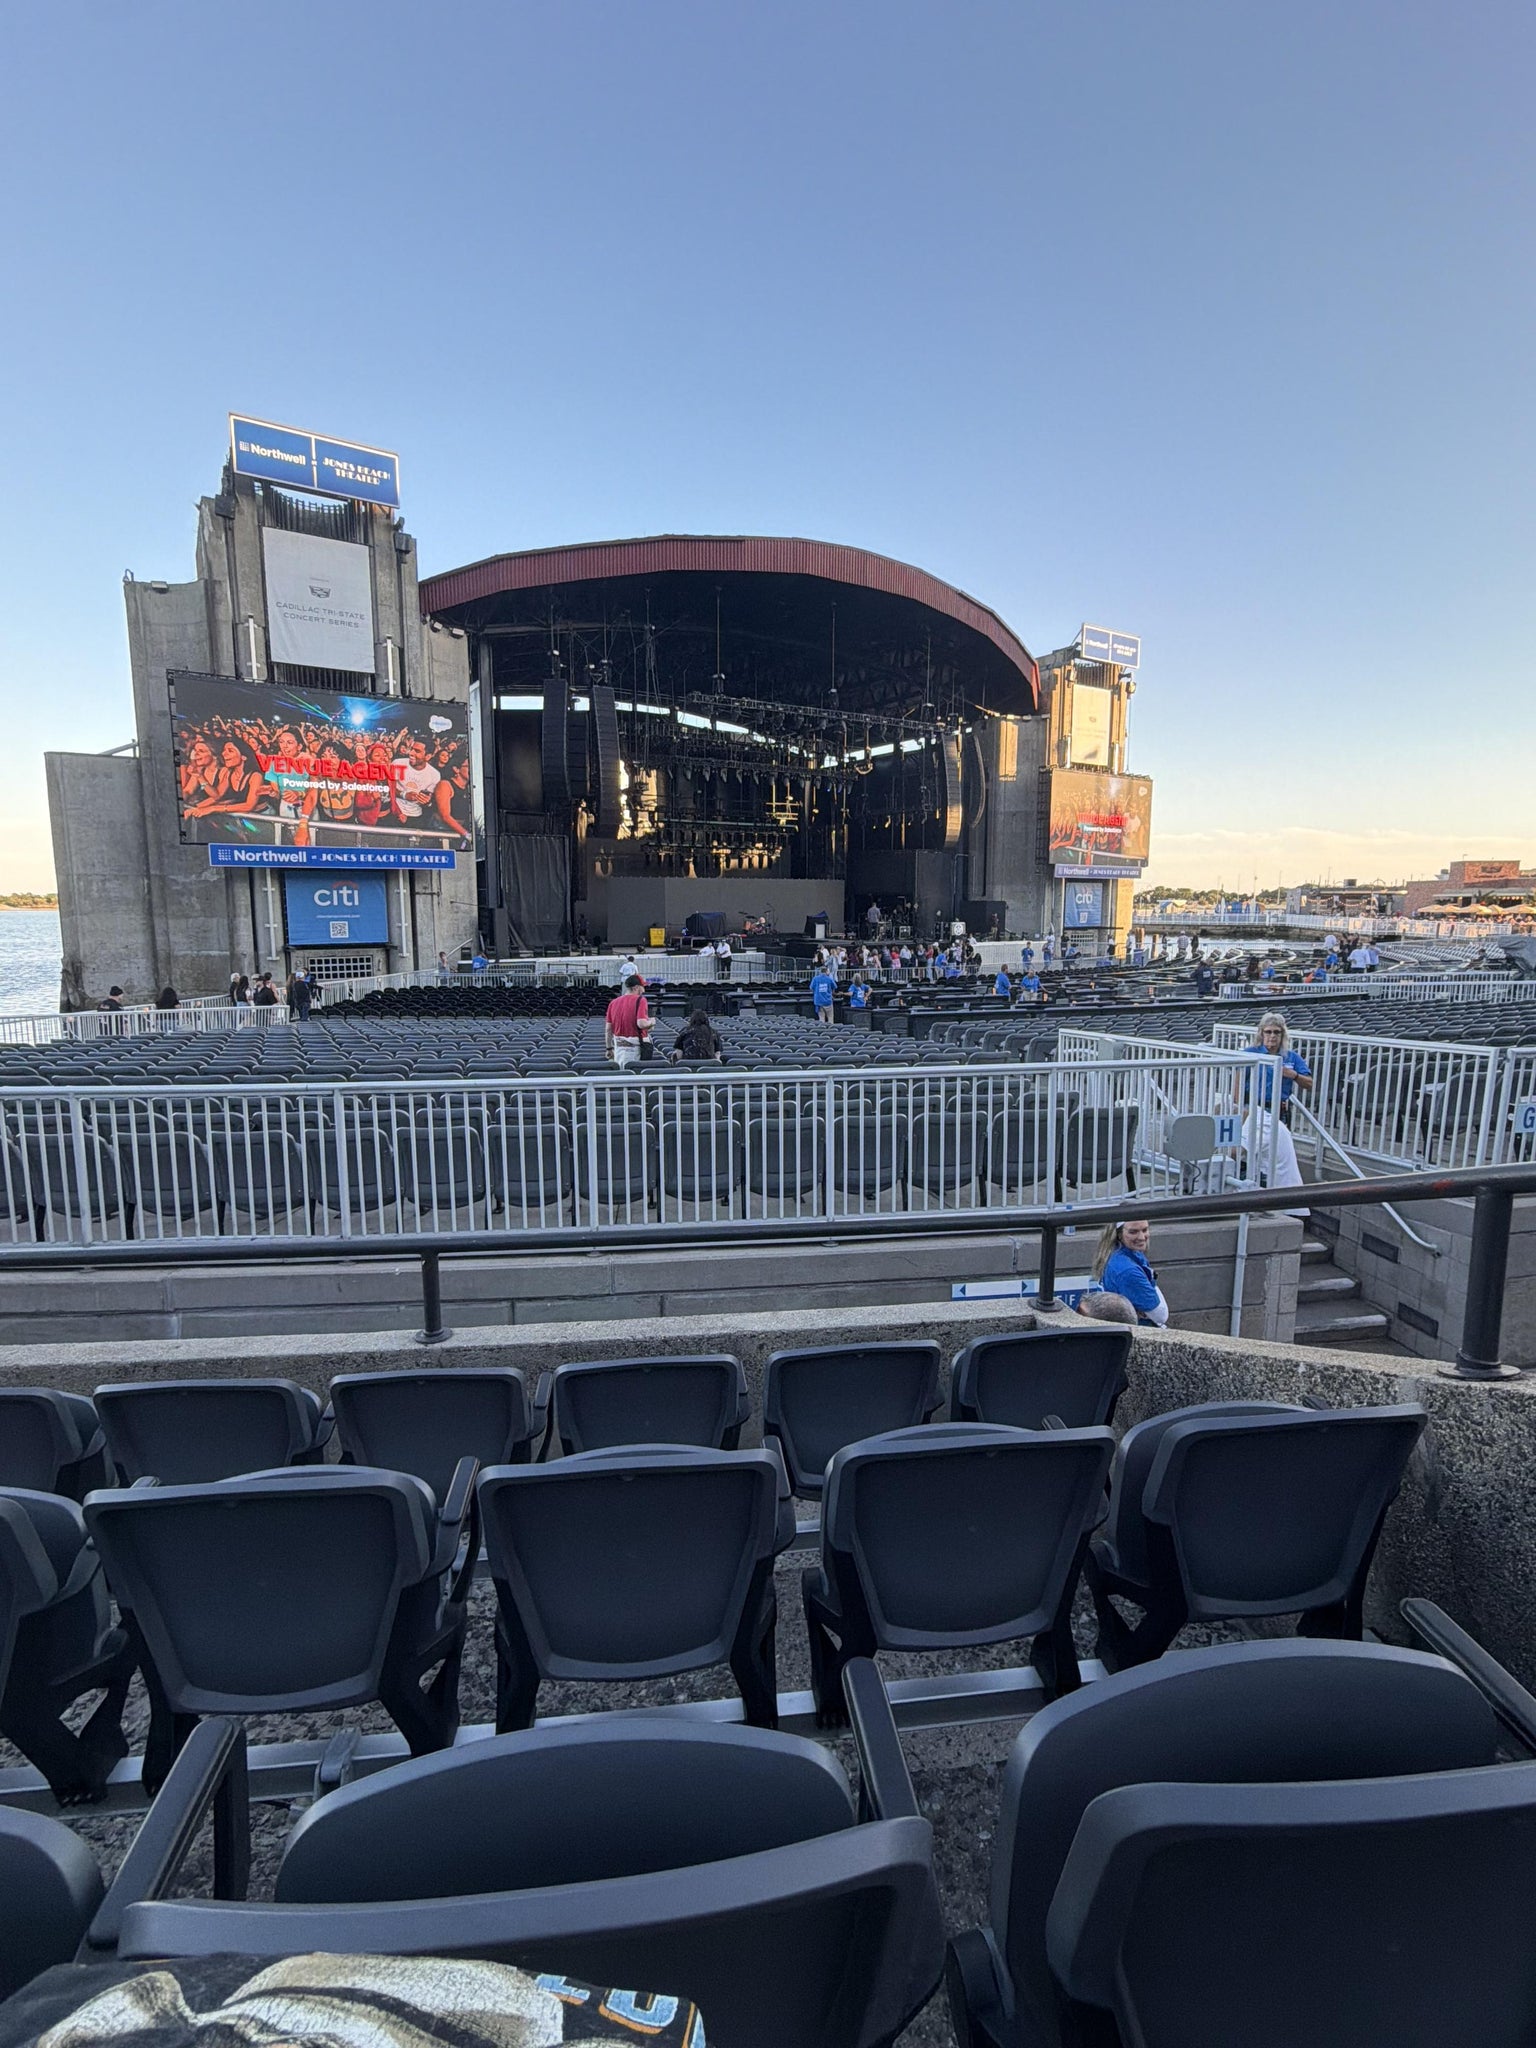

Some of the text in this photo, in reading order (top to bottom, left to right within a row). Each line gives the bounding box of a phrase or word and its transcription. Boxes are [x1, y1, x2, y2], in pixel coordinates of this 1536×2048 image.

[250, 443, 306, 466] Northwell
[322, 457, 355, 472] JONES
[275, 601, 320, 614] CADILLAC
[283, 612, 360, 629] CONCERT SERIES
[255, 754, 409, 781] VENUE AGENT
[282, 778, 326, 790] Powered
[327, 780, 341, 791] by
[233, 849, 307, 863] Northwell
[320, 853, 357, 862] JONES
[360, 853, 397, 863] BEACH
[400, 854, 450, 864] THEATER
[313, 885, 359, 907] citi
[1523, 1106, 1536, 1129] G
[1219, 1118, 1234, 1143] H
